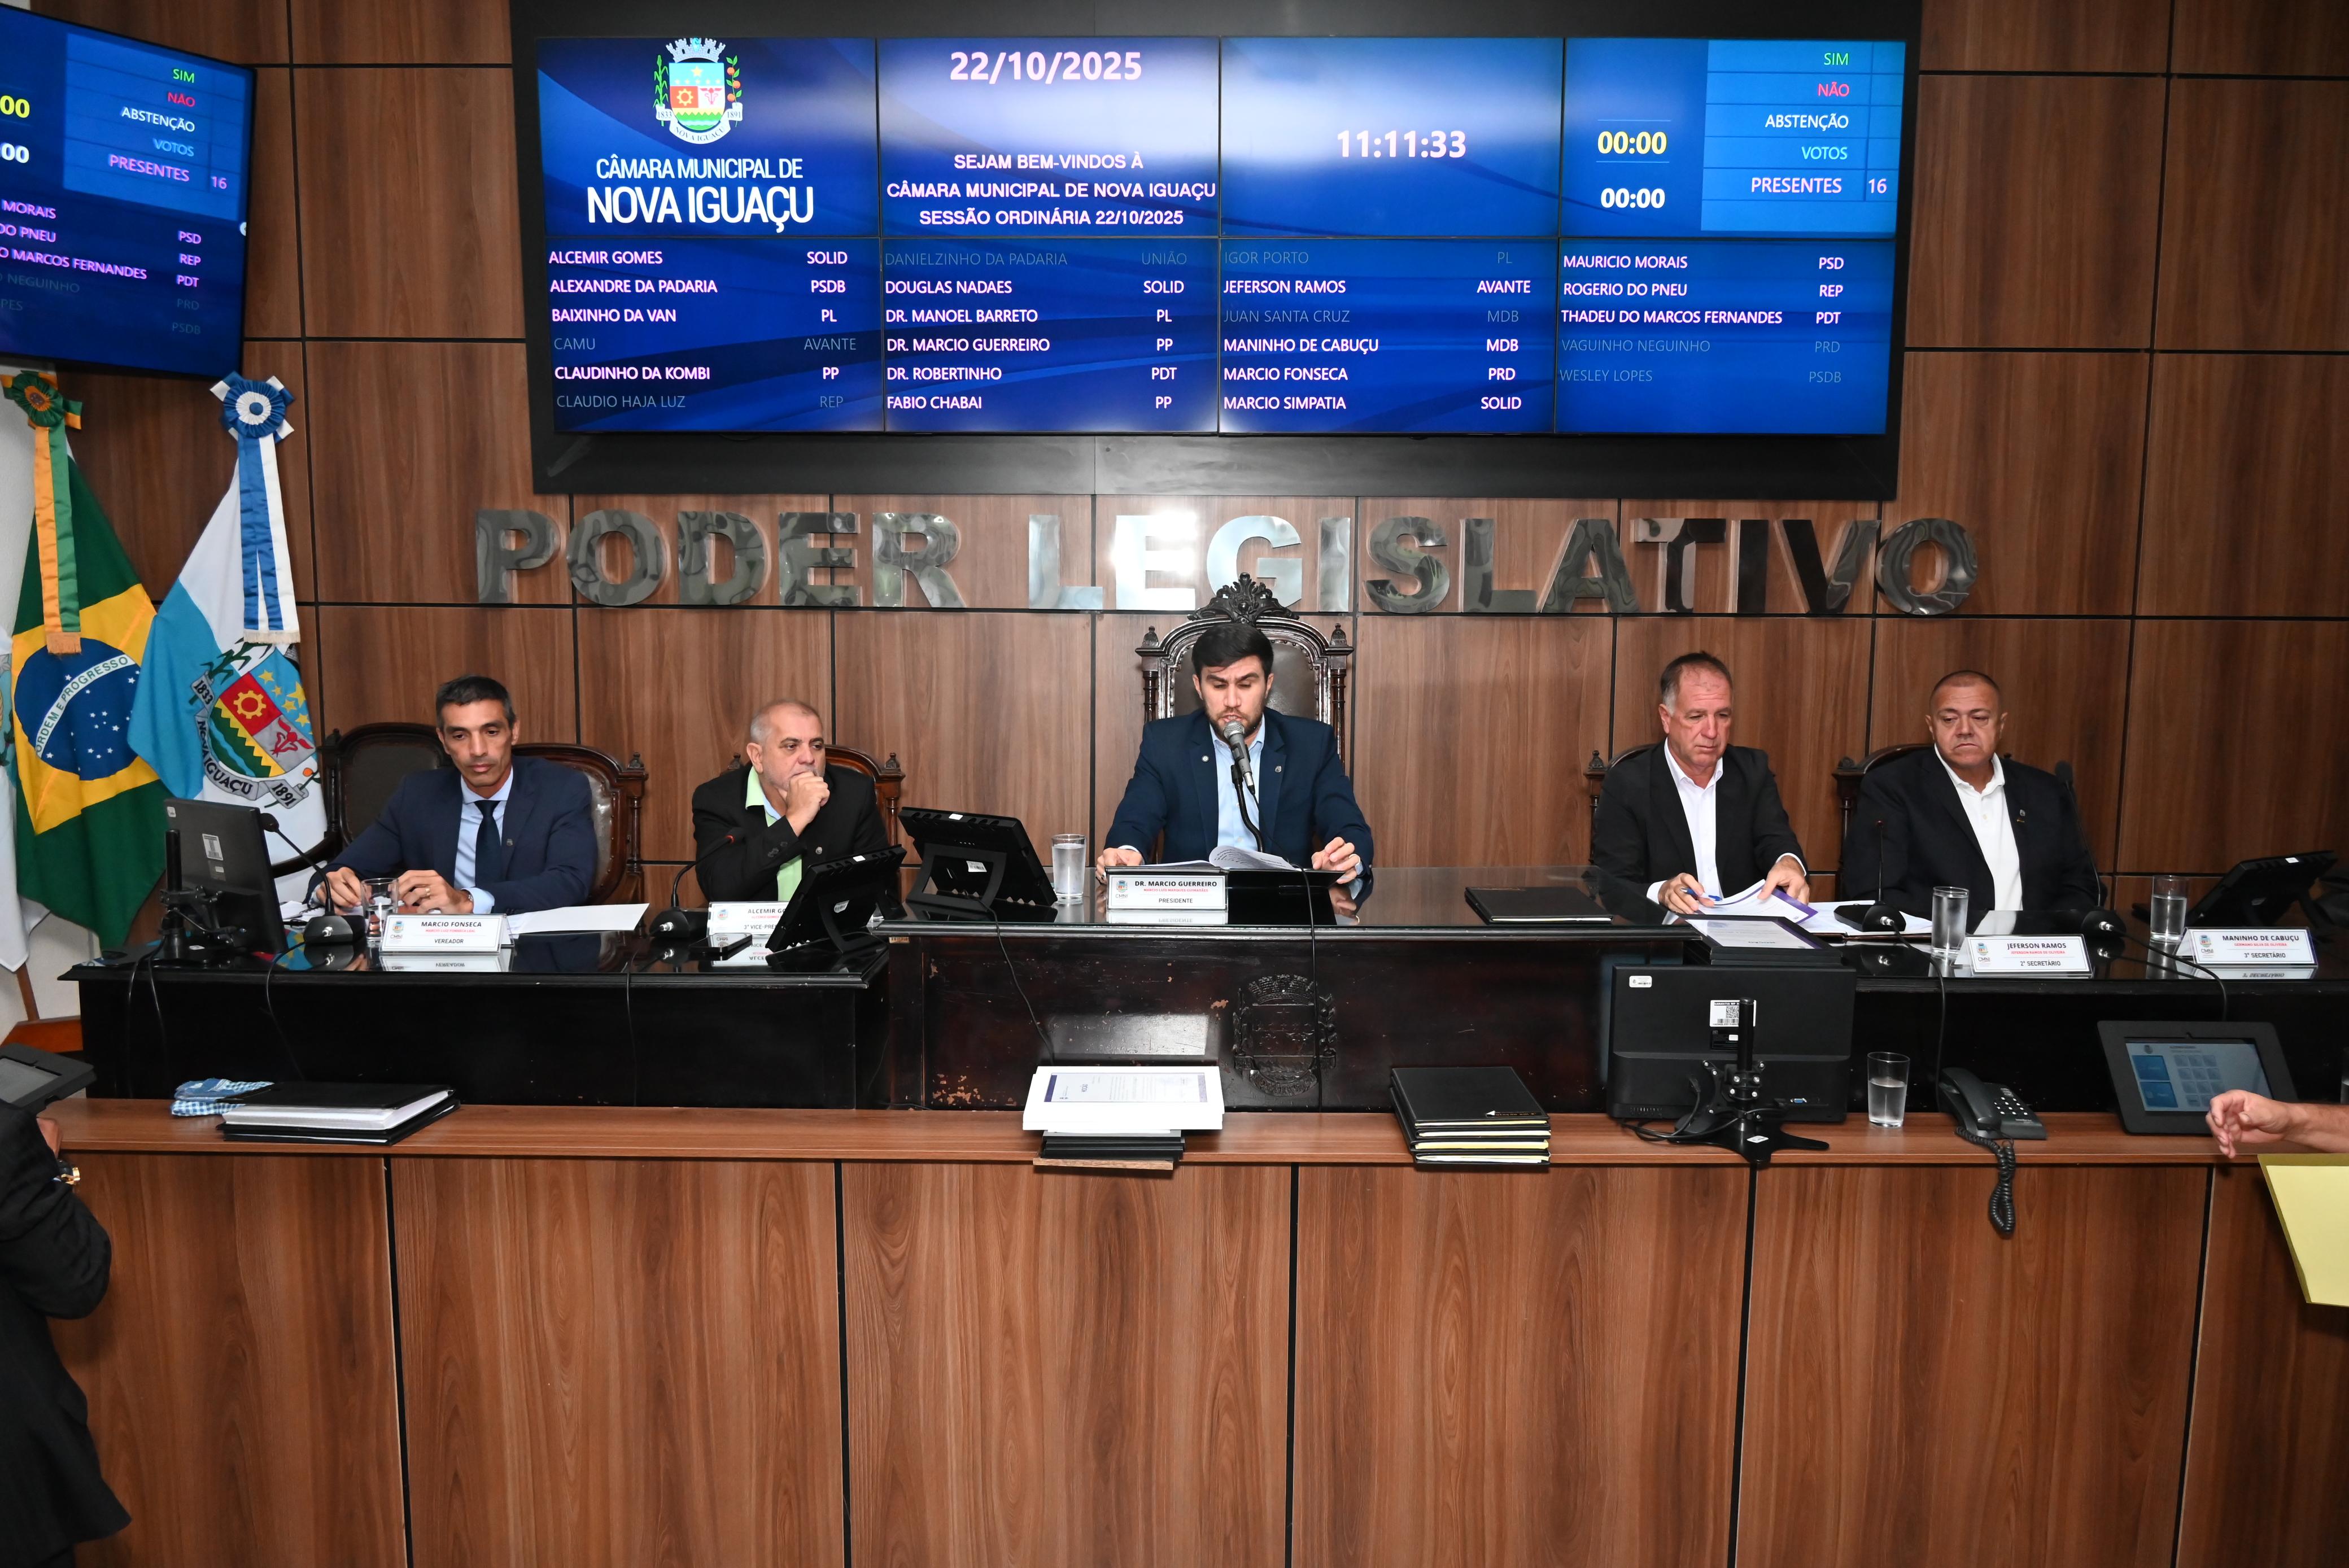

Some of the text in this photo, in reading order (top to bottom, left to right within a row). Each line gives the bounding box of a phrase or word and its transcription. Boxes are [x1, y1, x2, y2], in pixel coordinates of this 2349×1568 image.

[1824, 53, 1849, 65] SIM
[950, 52, 1142, 84] 22/10/2025
[173, 69, 194, 82] SIM
[1818, 81, 1850, 97] NÃO
[167, 92, 195, 107] NÃO
[121, 106, 195, 133] ABSTENÇÃO
[1765, 113, 1849, 131] ABSTENÇÃO
[675, 126, 726, 142] NOVA IGUAÇU
[153, 138, 194, 156] VOTOS
[1337, 130, 1466, 158] 11:11:33
[1598, 131, 1667, 154] 00:00
[1802, 147, 1847, 159] VOTOS
[597, 154, 803, 178] CÂMARA MUNICIPAL DE
[954, 151, 1143, 169] SEJAM BEM-VINDOS À
[109, 155, 226, 189] PRESENTES 16
[887, 180, 1215, 200] CÂMARA MUNICIPAL DE NOVA IGUAÇU
[1752, 177, 1887, 193] PRESENTES 16
[1601, 188, 1665, 208] 00:00
[2, 200, 56, 219] MORAIS
[588, 186, 813, 233] NOVA IGUAÇU
[920, 207, 1183, 225] SESSÃO ORDINÁRIA 22/10/2025
[20, 226, 56, 242] PNEU
[178, 231, 201, 244] PSD
[12, 249, 147, 279] MARCOS FERNANDES
[180, 254, 200, 265] REP
[549, 251, 662, 264] ALCEMIR GOMES
[807, 251, 848, 264] SOLID
[885, 253, 1067, 265] DANIELZINHO DA PADARIA
[1142, 250, 1187, 265] UNIÃO
[1225, 252, 1309, 264] IGOR PORTO
[1564, 256, 1687, 268] MAURICIO MORAIS
[1819, 257, 1844, 269] PSD
[177, 275, 199, 287] PDT
[551, 279, 718, 292] ALEXANDRE DA PADARIA
[811, 280, 845, 292] PSDB
[886, 281, 1012, 293] DOUGLAS NADAES
[1144, 281, 1184, 293] SOLID
[1224, 281, 1346, 293] JEFERSON RAMOS
[1477, 281, 1530, 293] AVANTE
[1564, 283, 1687, 296] ROGERIO DO PNEU
[1820, 285, 1843, 297] REP
[552, 309, 676, 321] BAIXINHO DA VAN
[887, 309, 1038, 322] DR. MANOEL BARRETO
[1157, 309, 1172, 322] PL
[1224, 310, 1350, 323] JUAN SANTA CRUZ
[1561, 310, 1782, 324] THADEU DO MARCOS FERNANDES
[1817, 312, 1841, 324] PDT
[554, 338, 596, 350] CAMU
[888, 339, 1050, 351] DR. MARCIO GUERREIRO
[1157, 339, 1173, 351] PP
[1225, 339, 1378, 355] MANINHO DE CABUÇU
[1487, 339, 1518, 351] MDB
[1562, 339, 1710, 352] VAGUINHO NEGUINHO
[555, 367, 710, 379] CLAUDINHO DA KOMBI
[823, 367, 839, 379] PP
[888, 368, 1002, 379] DR. ROBERTINHO
[1152, 368, 1177, 379] PDT
[1224, 368, 1348, 380] MARCIO FONSECA
[1489, 368, 1515, 380] PRD
[1560, 370, 1652, 382] WESLEY LOPES
[557, 396, 686, 408] CLAUDIO HAJA LUZ
[820, 396, 843, 408] REP
[888, 396, 981, 408] FABIO CHABAI
[1224, 397, 1346, 409] MARCIO SIMPATIA
[1481, 397, 1521, 409] SOLID
[475, 509, 1978, 615] PODER LEGISLATIVO
[194, 680, 213, 705] 1833
[36, 711, 59, 752] ORDEM
[62, 657, 128, 701] PROGRESSO
[204, 758, 253, 794] IGUAÇU
[272, 784, 296, 806] 1891
